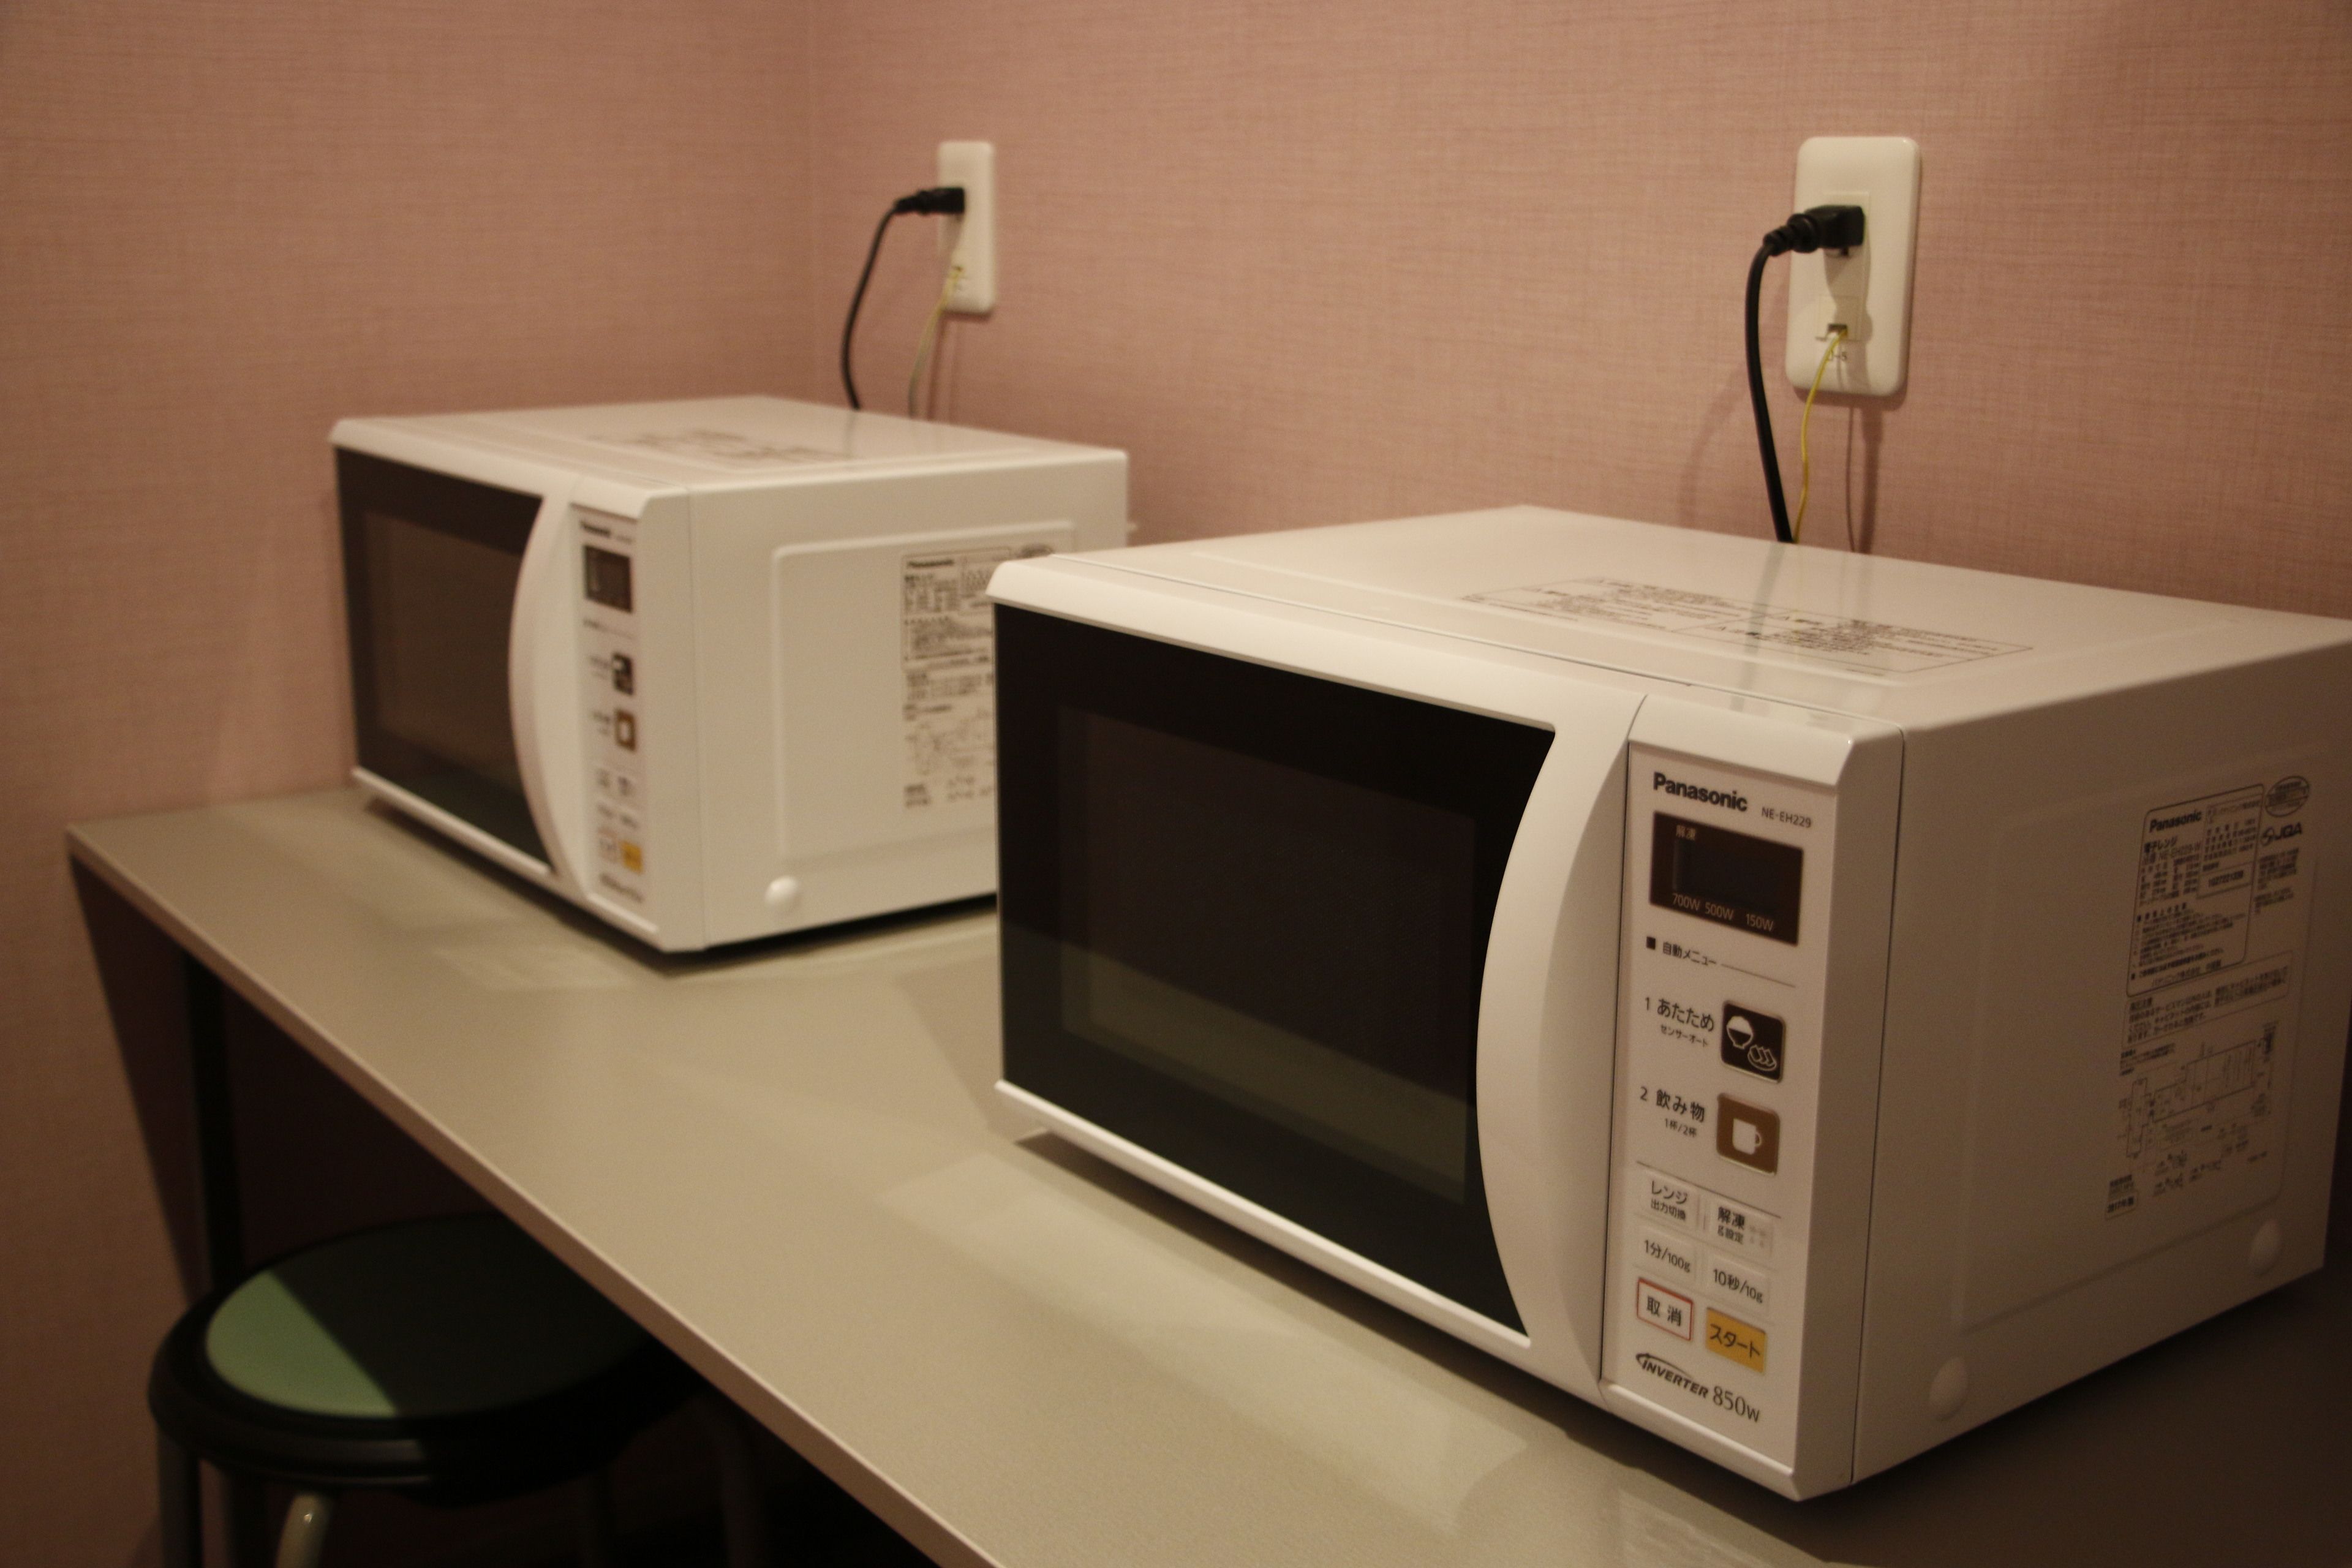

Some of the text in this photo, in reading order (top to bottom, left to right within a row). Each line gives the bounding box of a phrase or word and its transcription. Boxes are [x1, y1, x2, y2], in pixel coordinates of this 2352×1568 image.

[1653, 772, 1812, 829] Panasonic NE-EH229
[2149, 810, 2203, 833] Panasonic
[1672, 892, 1774, 932] 700W 500W 150W
[1662, 941, 1717, 966] 自動メニュー
[1644, 997, 1714, 1032] 1 あたため
[1660, 1024, 1708, 1047] センサーオート
[1640, 1086, 1705, 1123] 2 飲み物
[1664, 1118, 1697, 1138] 1杯/2杯
[1651, 1180, 1688, 1204] レンジ
[1717, 1206, 1746, 1231] 解凍
[1644, 1238, 1691, 1274] 1分/100g
[1713, 1268, 1764, 1304] 10秒/10g
[1646, 1295, 1682, 1327] 取消
[1709, 1324, 1760, 1359] スタート
[1640, 1355, 1708, 1399] INVERTER
